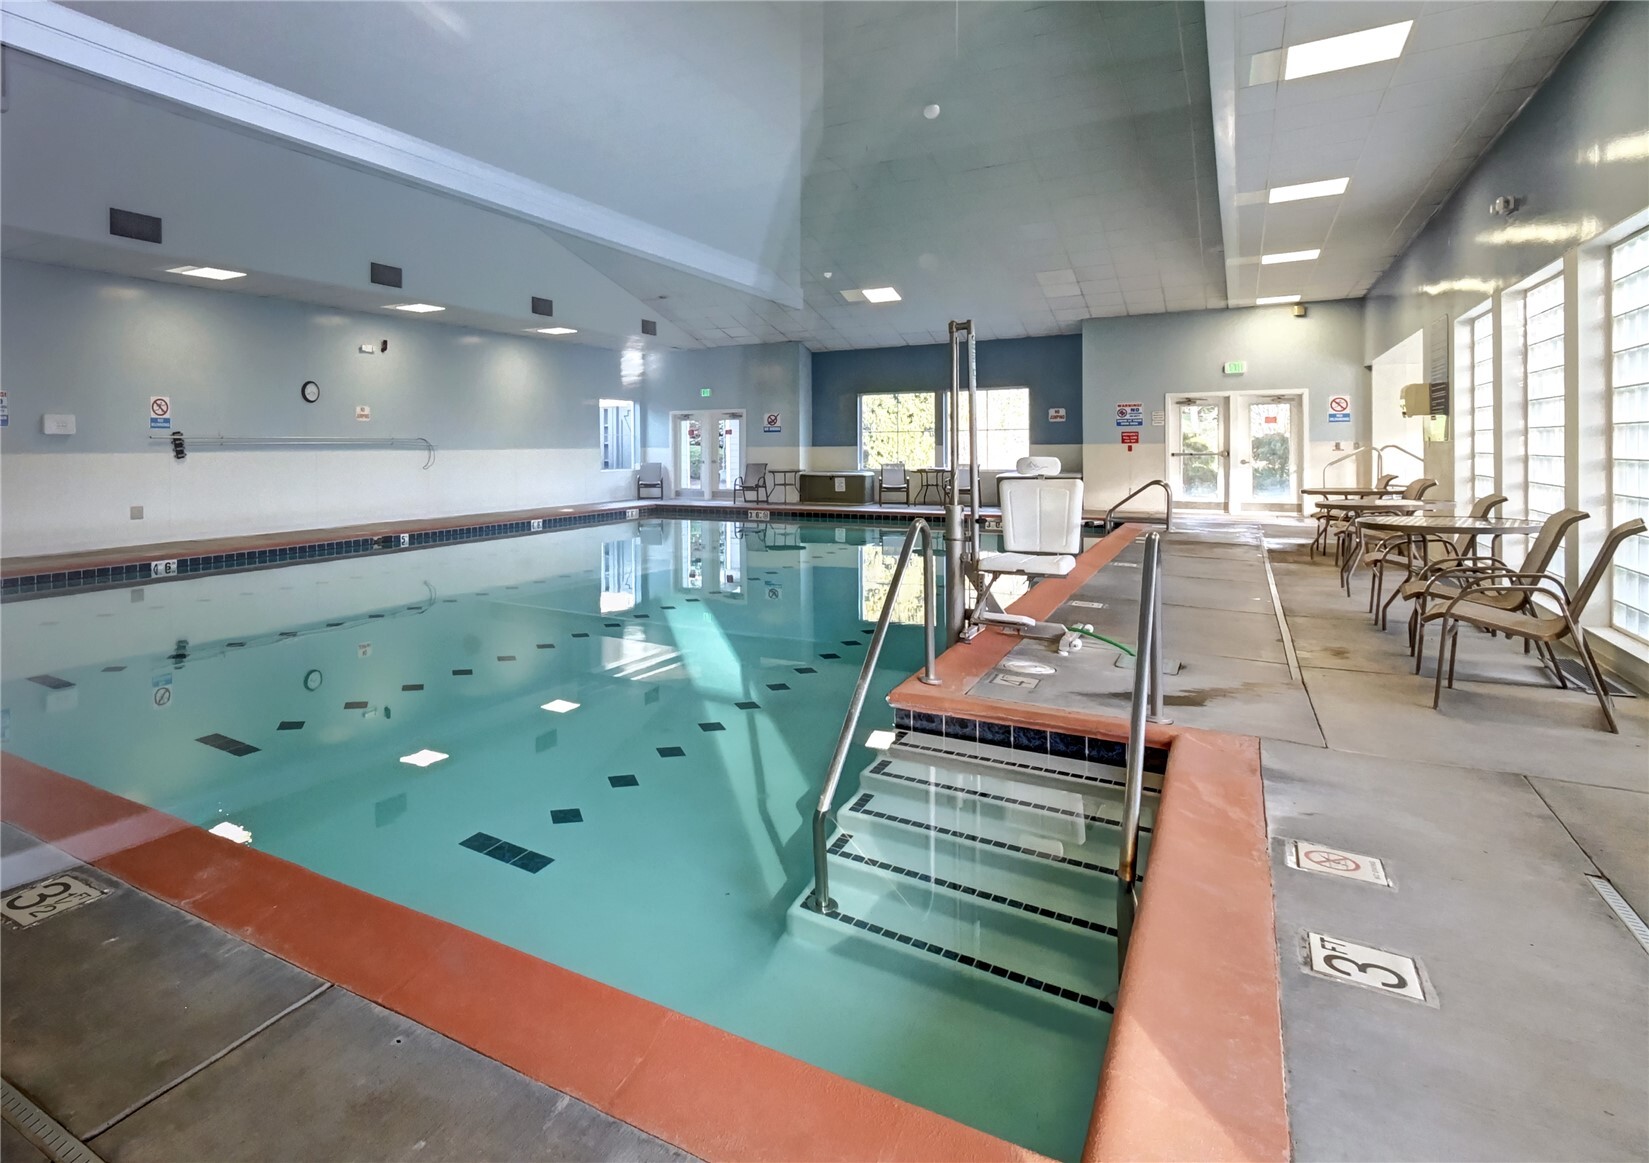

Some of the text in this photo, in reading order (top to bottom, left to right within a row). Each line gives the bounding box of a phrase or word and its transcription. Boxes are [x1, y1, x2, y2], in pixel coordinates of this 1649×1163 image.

[401, 535, 406, 546] 5
[165, 561, 172, 575] 6
[6, 881, 72, 911] 3
[1319, 936, 1409, 990] 3 FT
